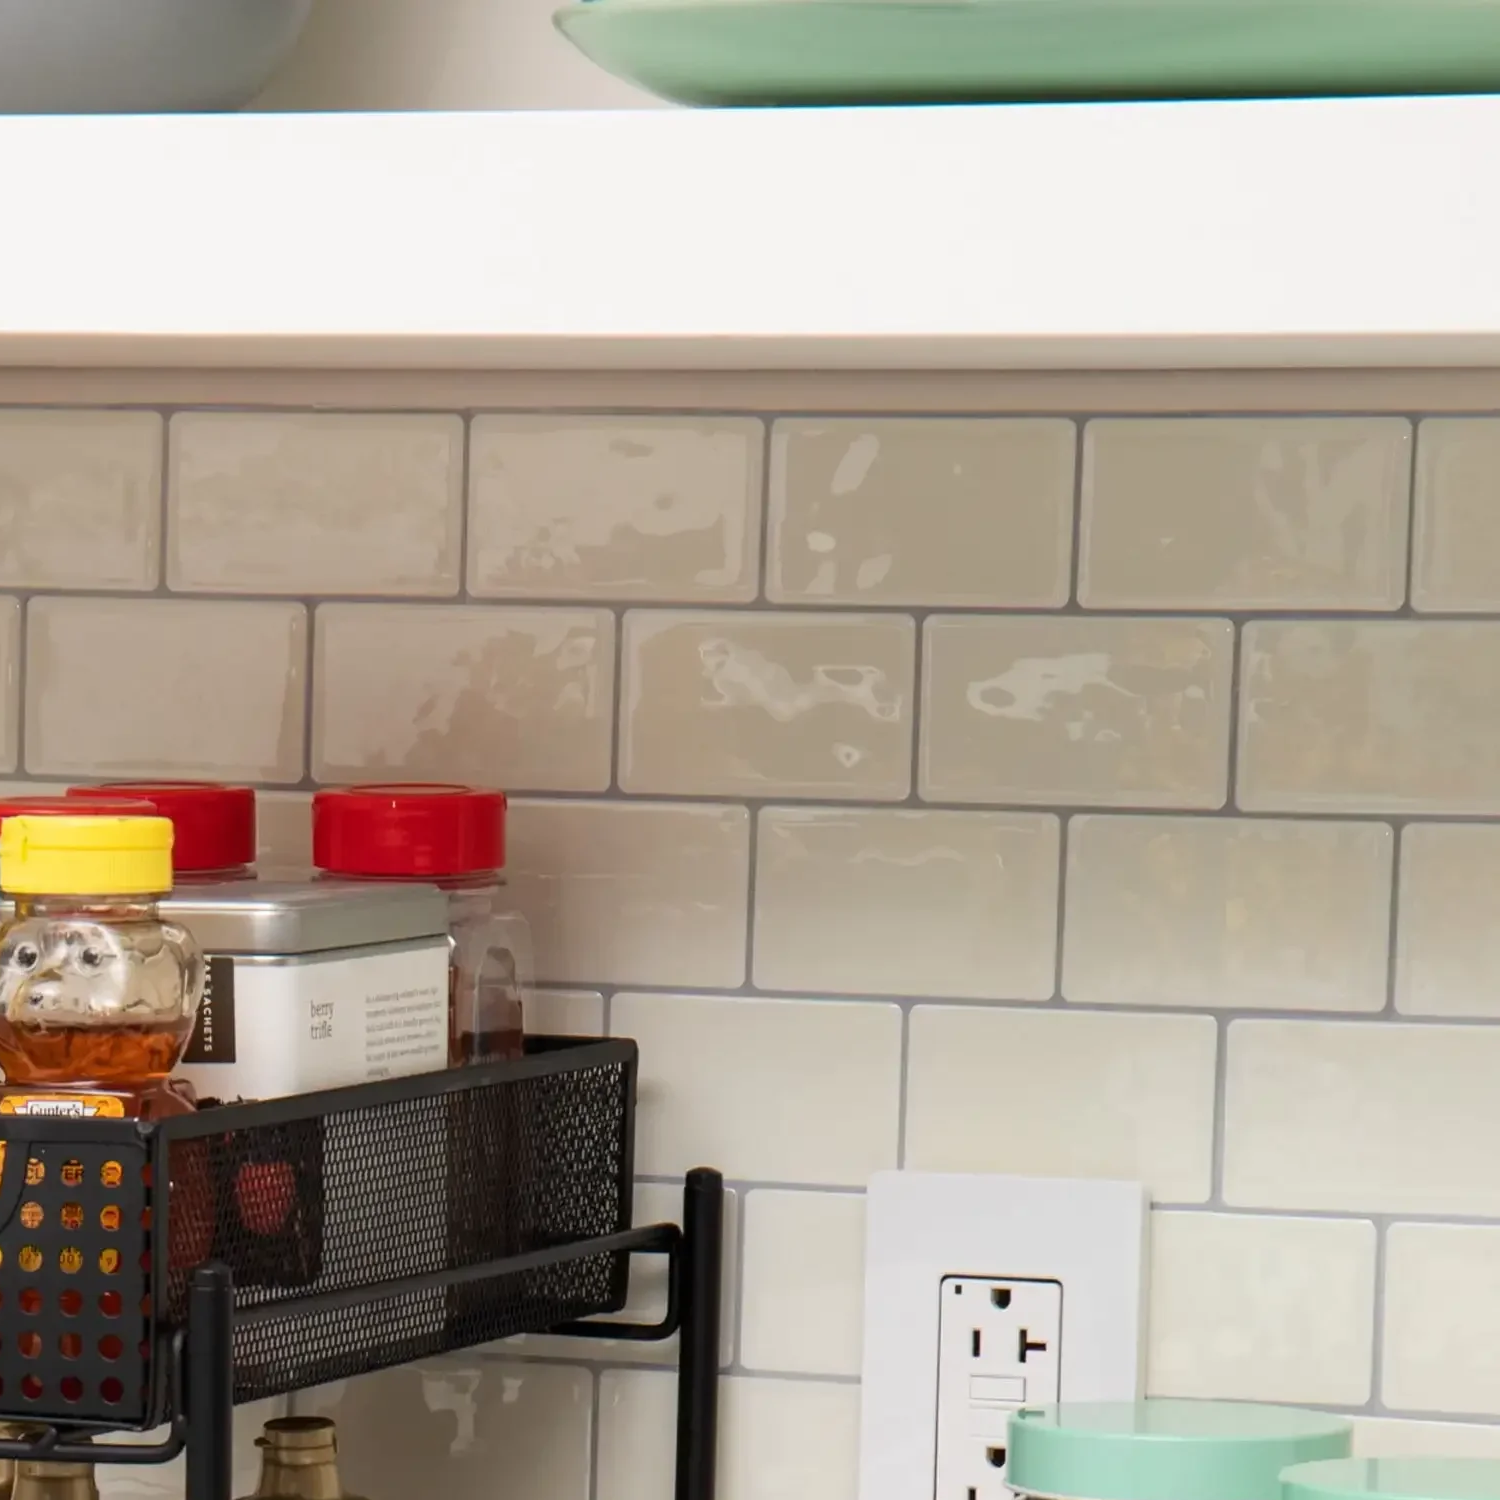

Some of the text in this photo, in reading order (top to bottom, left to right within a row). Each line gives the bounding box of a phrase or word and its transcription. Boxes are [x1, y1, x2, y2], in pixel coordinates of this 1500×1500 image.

[310, 999, 334, 1019] berry
[203, 987, 213, 1052] SACHETS
[310, 1020, 333, 1040] trifle
